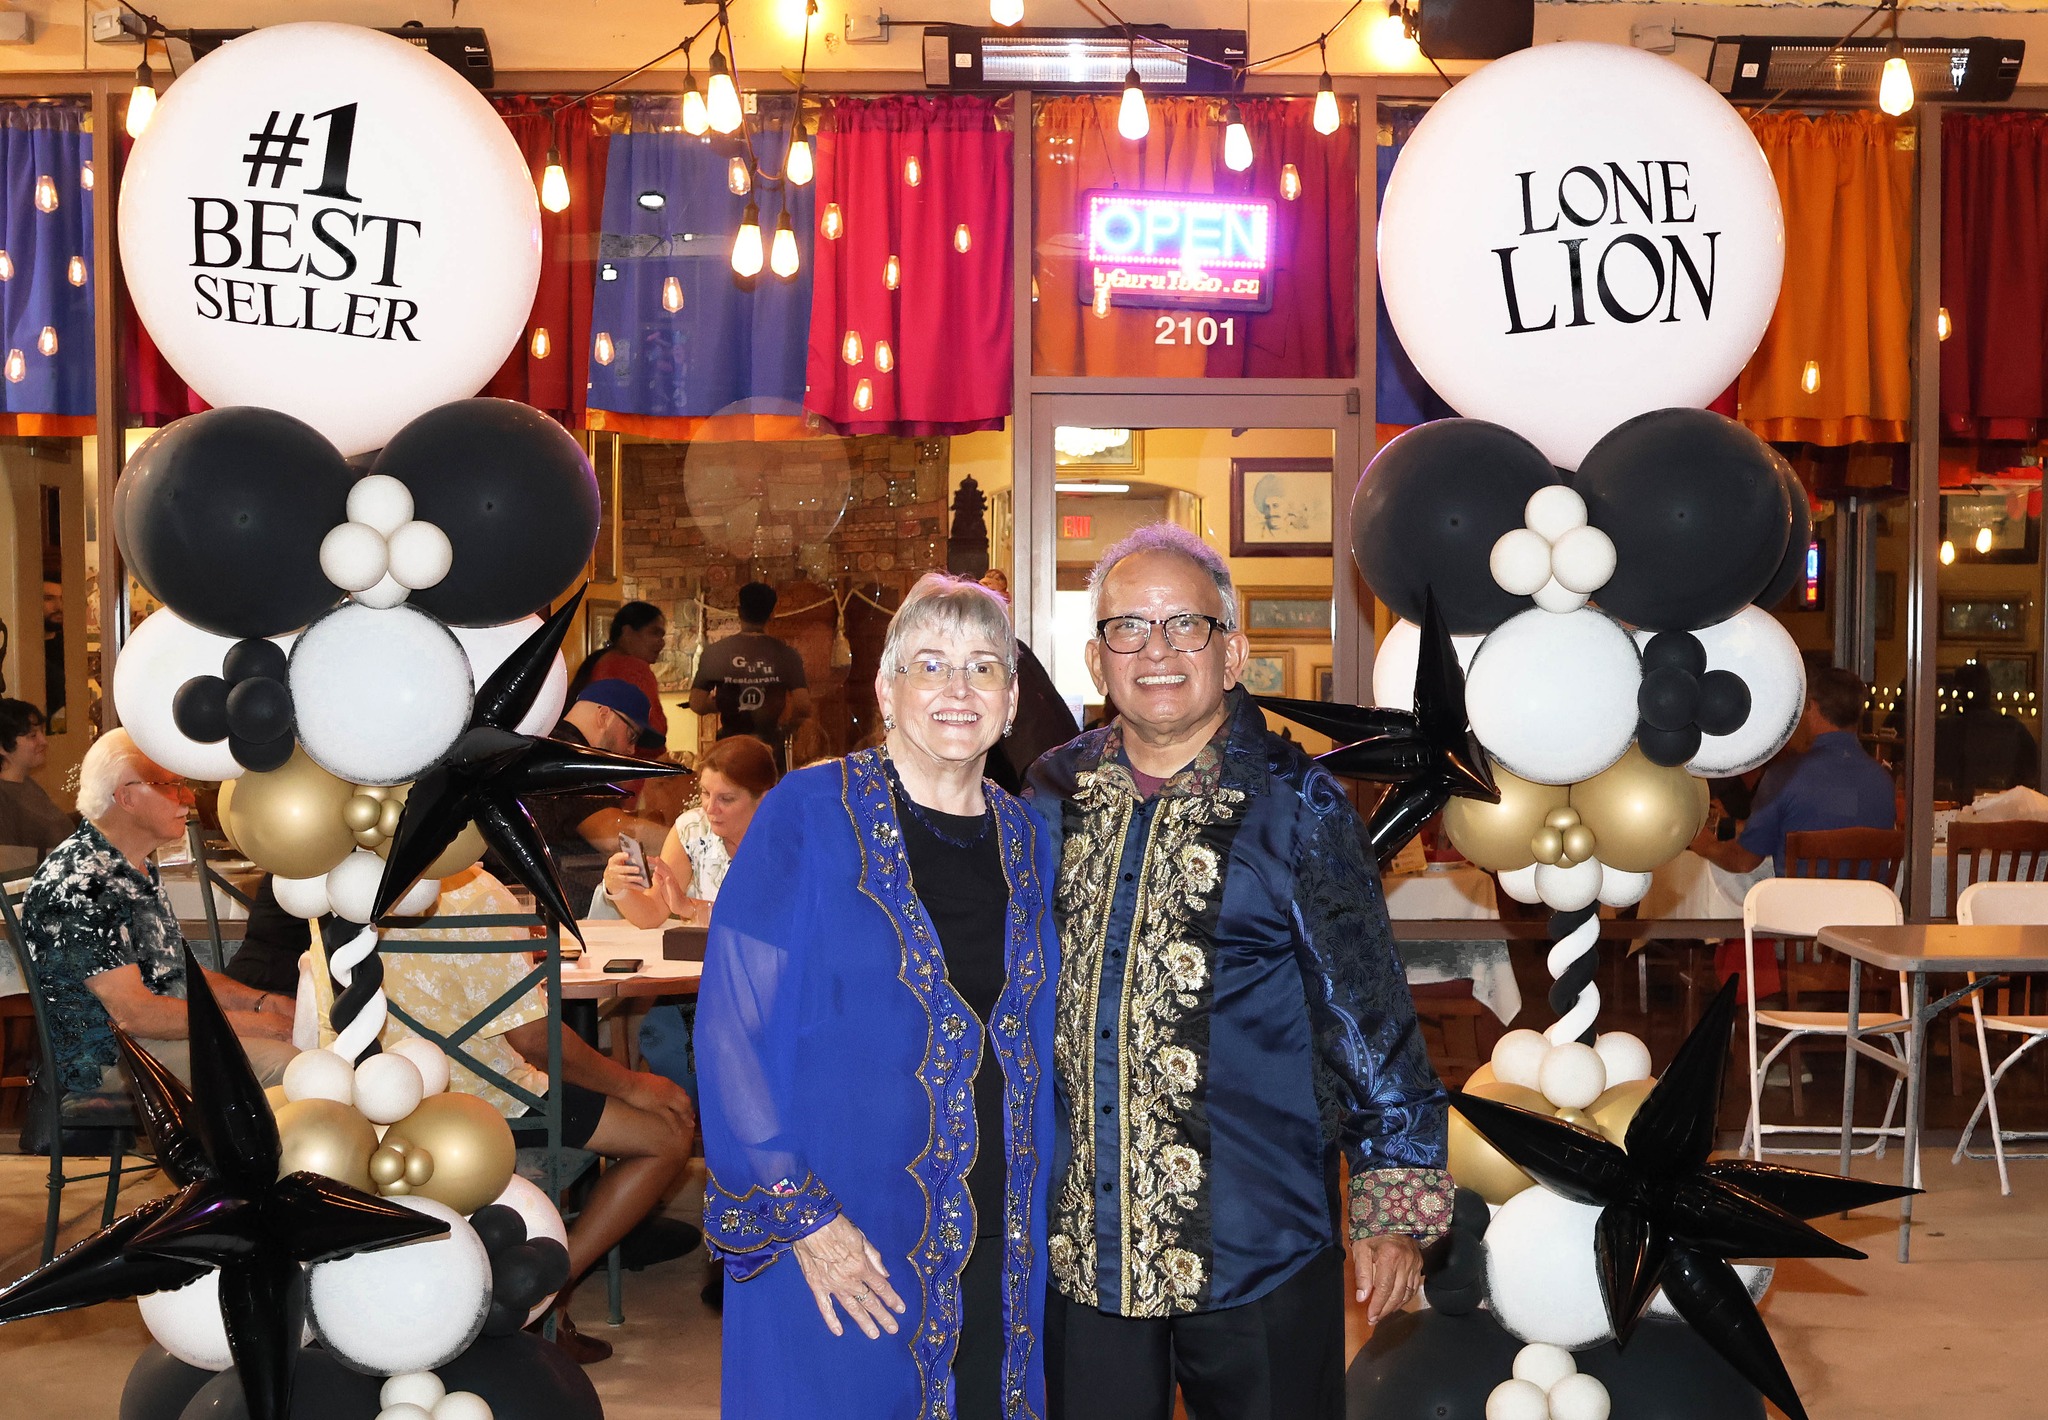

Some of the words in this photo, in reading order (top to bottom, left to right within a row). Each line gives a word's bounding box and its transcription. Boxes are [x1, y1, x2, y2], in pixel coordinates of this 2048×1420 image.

[242, 101, 363, 204] #1
[1514, 160, 1697, 236] LONE
[187, 196, 422, 288] BEST
[1097, 204, 1262, 259] OPEN
[193, 273, 422, 342] SELLER
[1490, 231, 1722, 335] LION
[1154, 315, 1234, 346] 2101
[1063, 515, 1092, 539] EXIT
[723, 675, 780, 684] Restaurant
[732, 656, 774, 674] Guru
